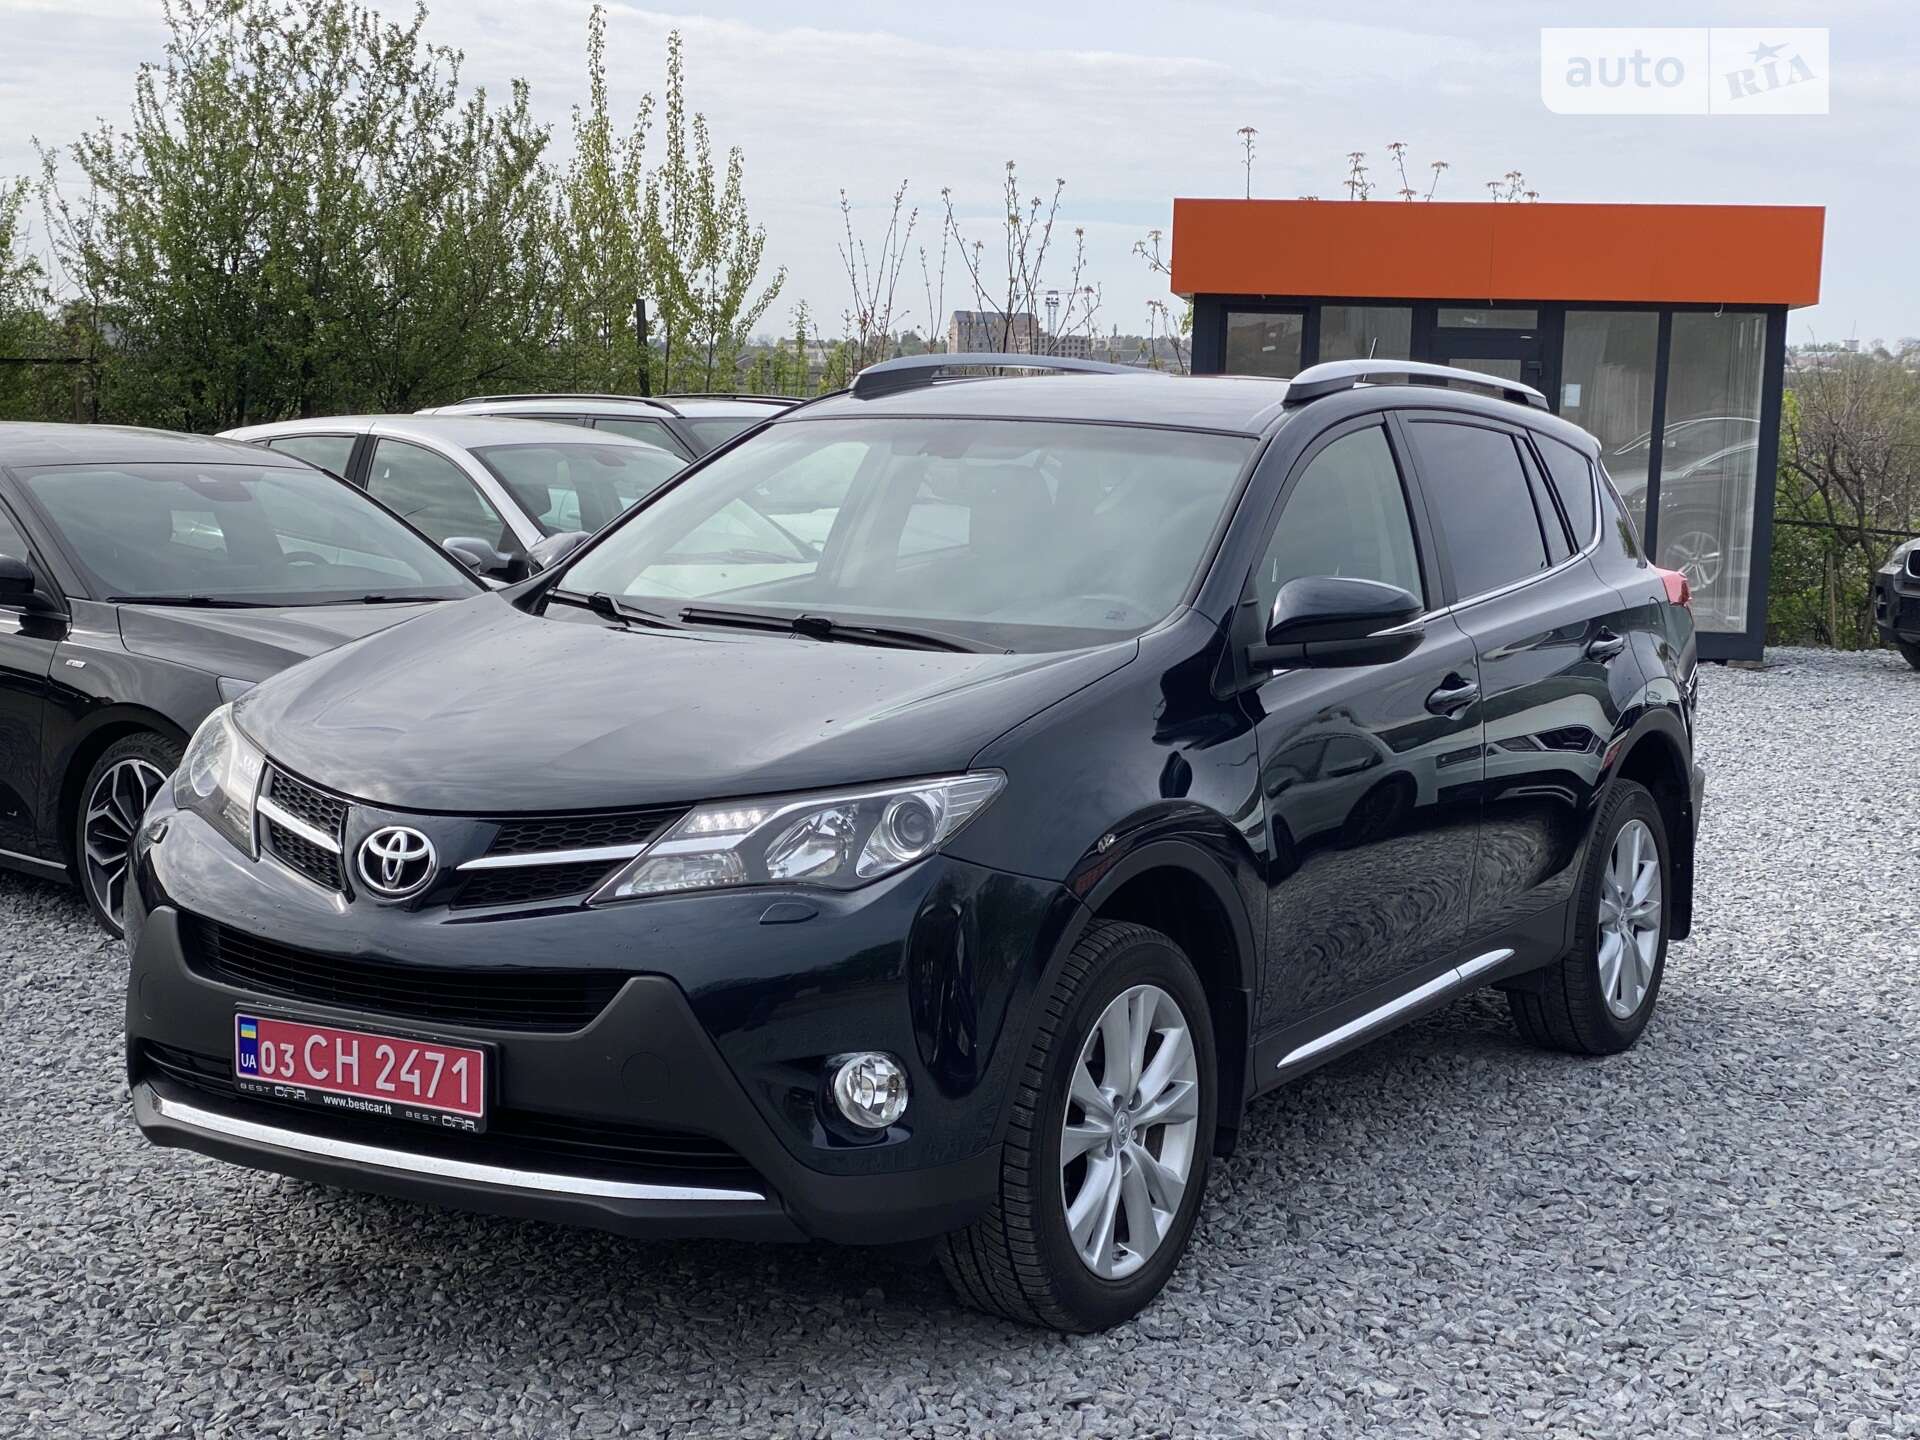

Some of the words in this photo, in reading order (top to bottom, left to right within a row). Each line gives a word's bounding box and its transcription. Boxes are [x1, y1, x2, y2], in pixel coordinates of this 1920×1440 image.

[240, 1053, 258, 1069] UA
[260, 1040, 296, 1078] 03
[303, 1034, 360, 1086] CH
[375, 1044, 469, 1104] 2471
[240, 1082, 271, 1093] BEST
[322, 1094, 393, 1115] www.bestcar.lt
[405, 1110, 438, 1122] BEST
